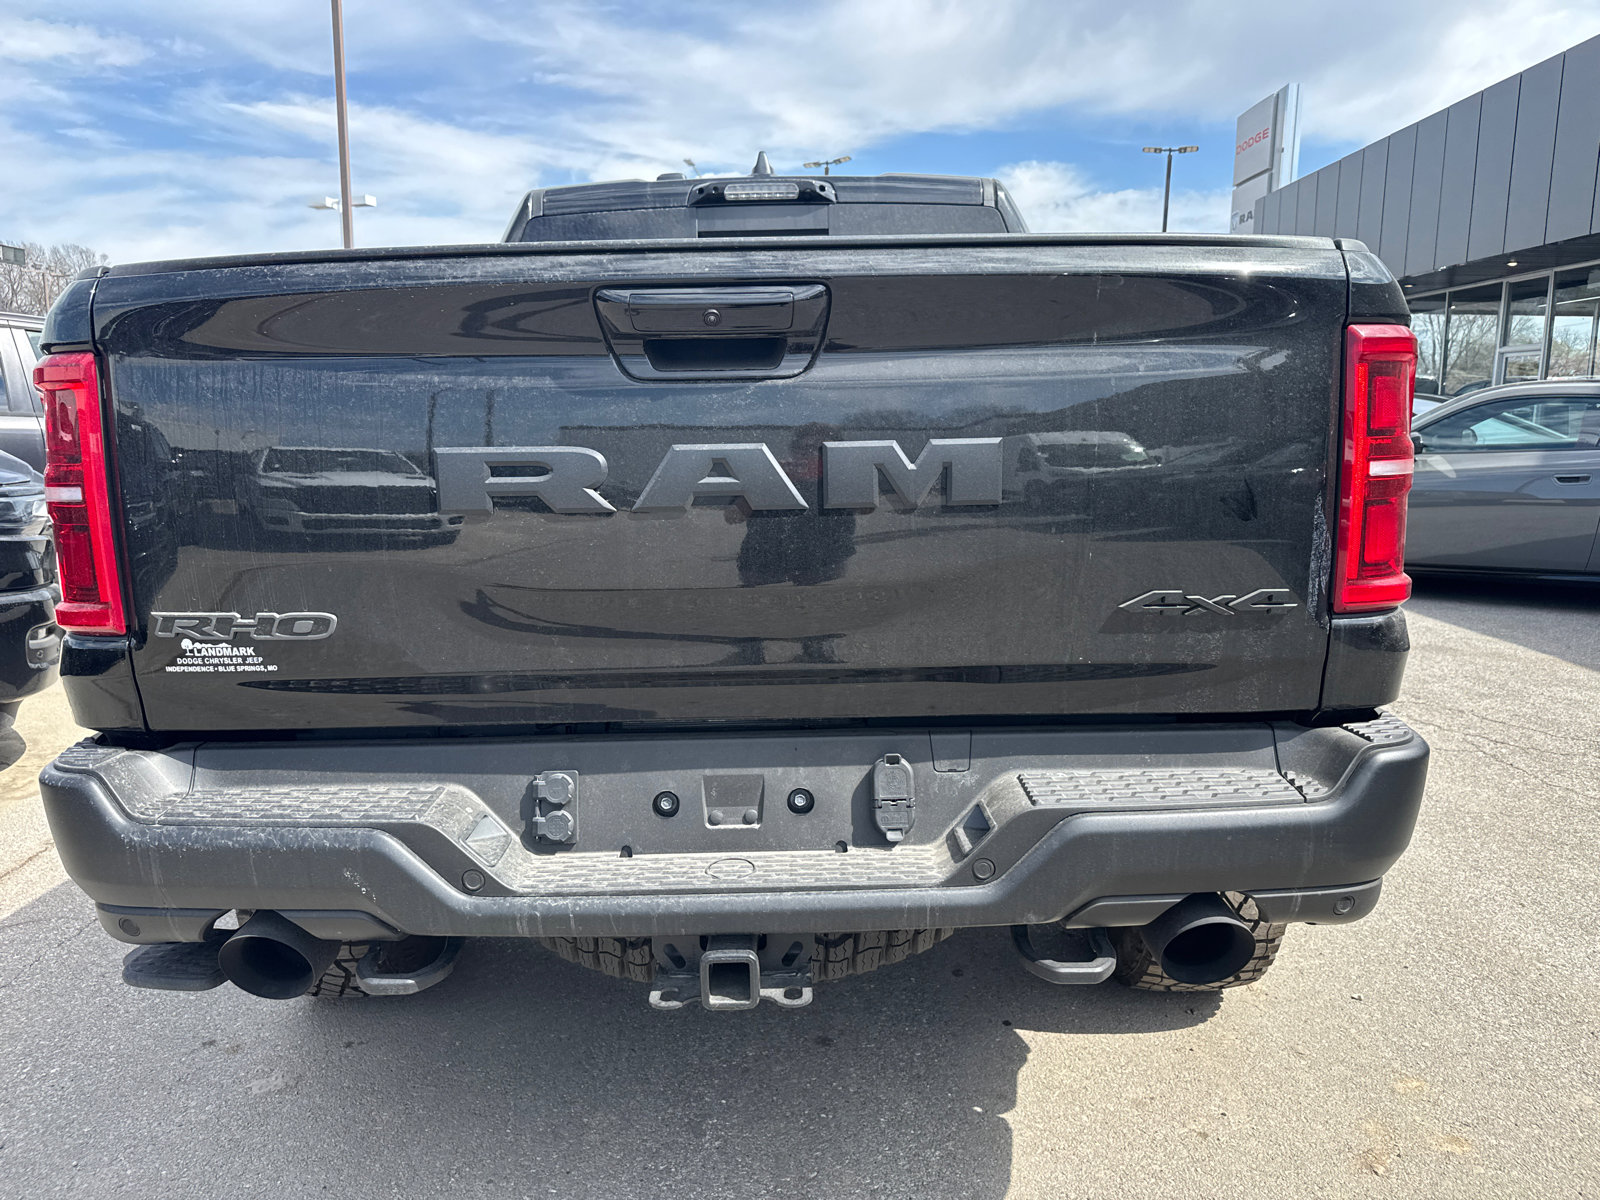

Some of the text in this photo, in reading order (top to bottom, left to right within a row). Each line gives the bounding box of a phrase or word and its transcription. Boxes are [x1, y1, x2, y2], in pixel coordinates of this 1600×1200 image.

[1236, 127, 1270, 155] DODGE
[434, 437, 1003, 513] RAM
[150, 611, 338, 640] RHO
[193, 646, 256, 656] LANDMARK
[245, 656, 263, 664] JEEP
